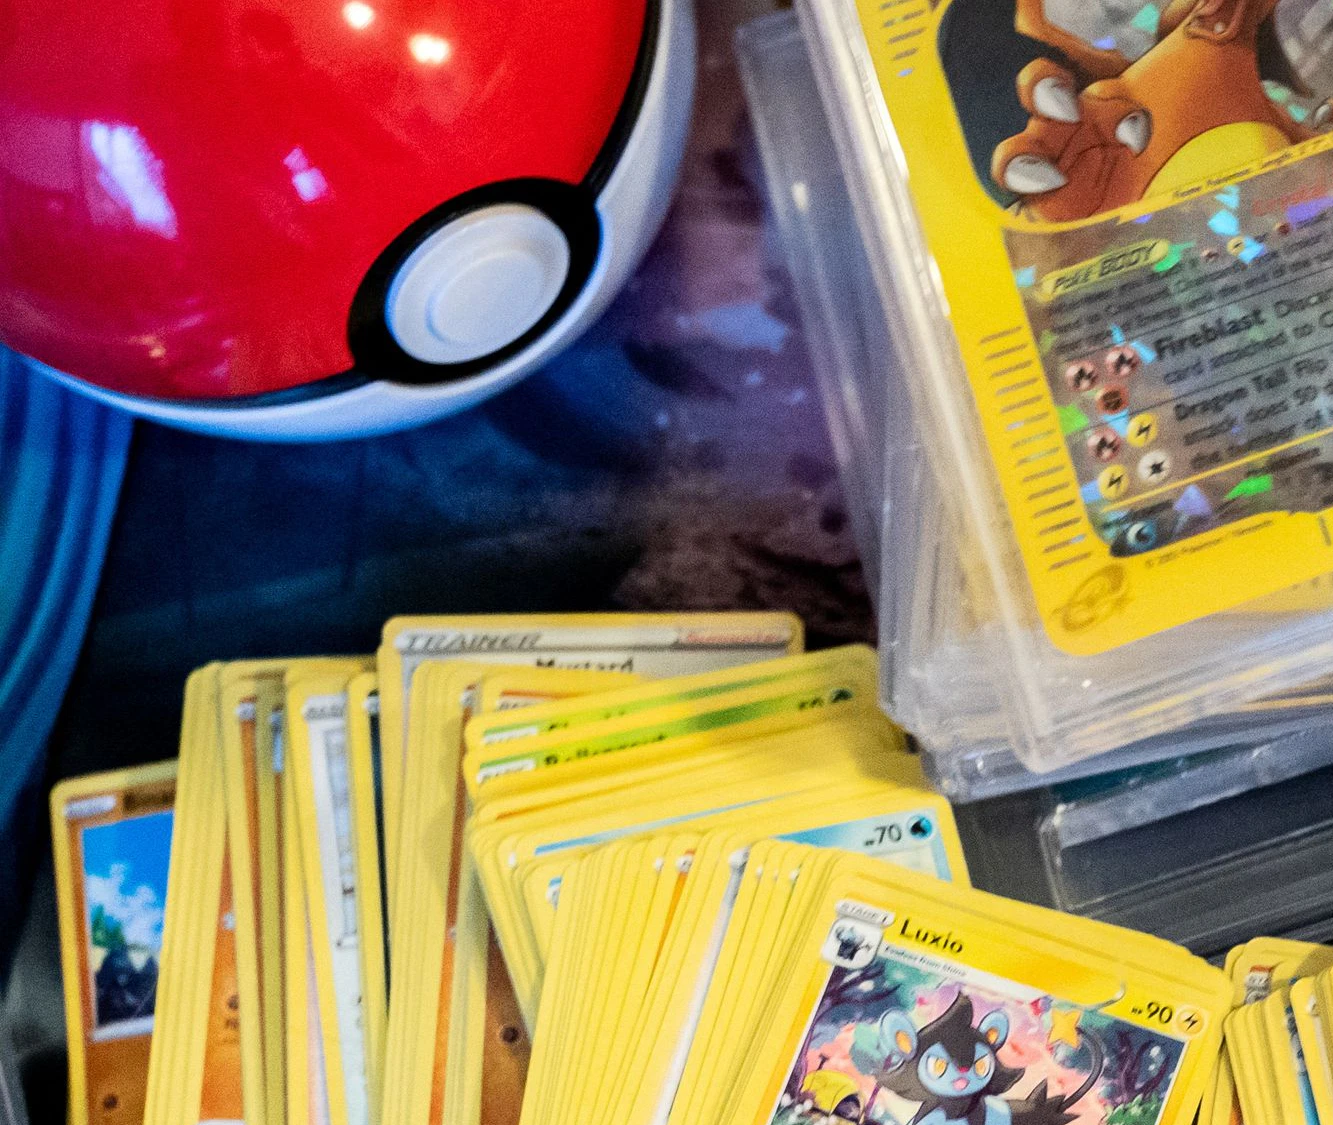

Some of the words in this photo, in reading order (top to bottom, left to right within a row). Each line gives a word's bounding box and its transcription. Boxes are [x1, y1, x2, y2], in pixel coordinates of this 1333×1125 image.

[1151, 306, 1265, 361] Fireblast
[875, 823, 903, 844] 70
[900, 917, 965, 956] Luxio
[1145, 1002, 1174, 1025] 90
